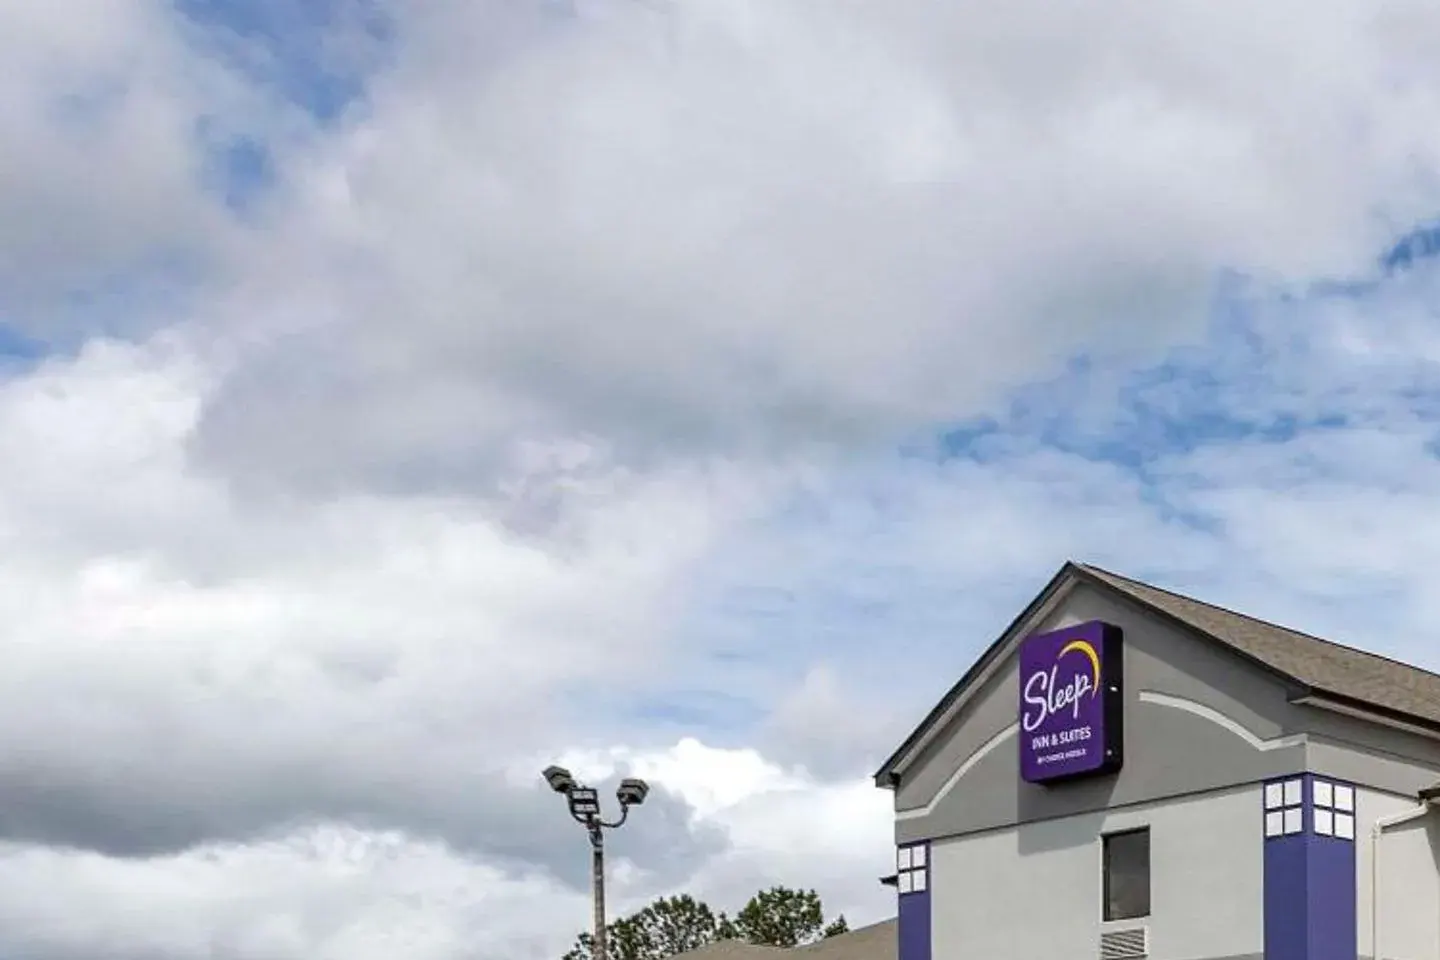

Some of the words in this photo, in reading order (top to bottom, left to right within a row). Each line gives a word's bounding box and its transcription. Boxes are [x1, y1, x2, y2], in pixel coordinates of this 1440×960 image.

[1023, 664, 1092, 731] Sleep
[1032, 735, 1050, 750] INN
[1059, 726, 1092, 744] SUITES
